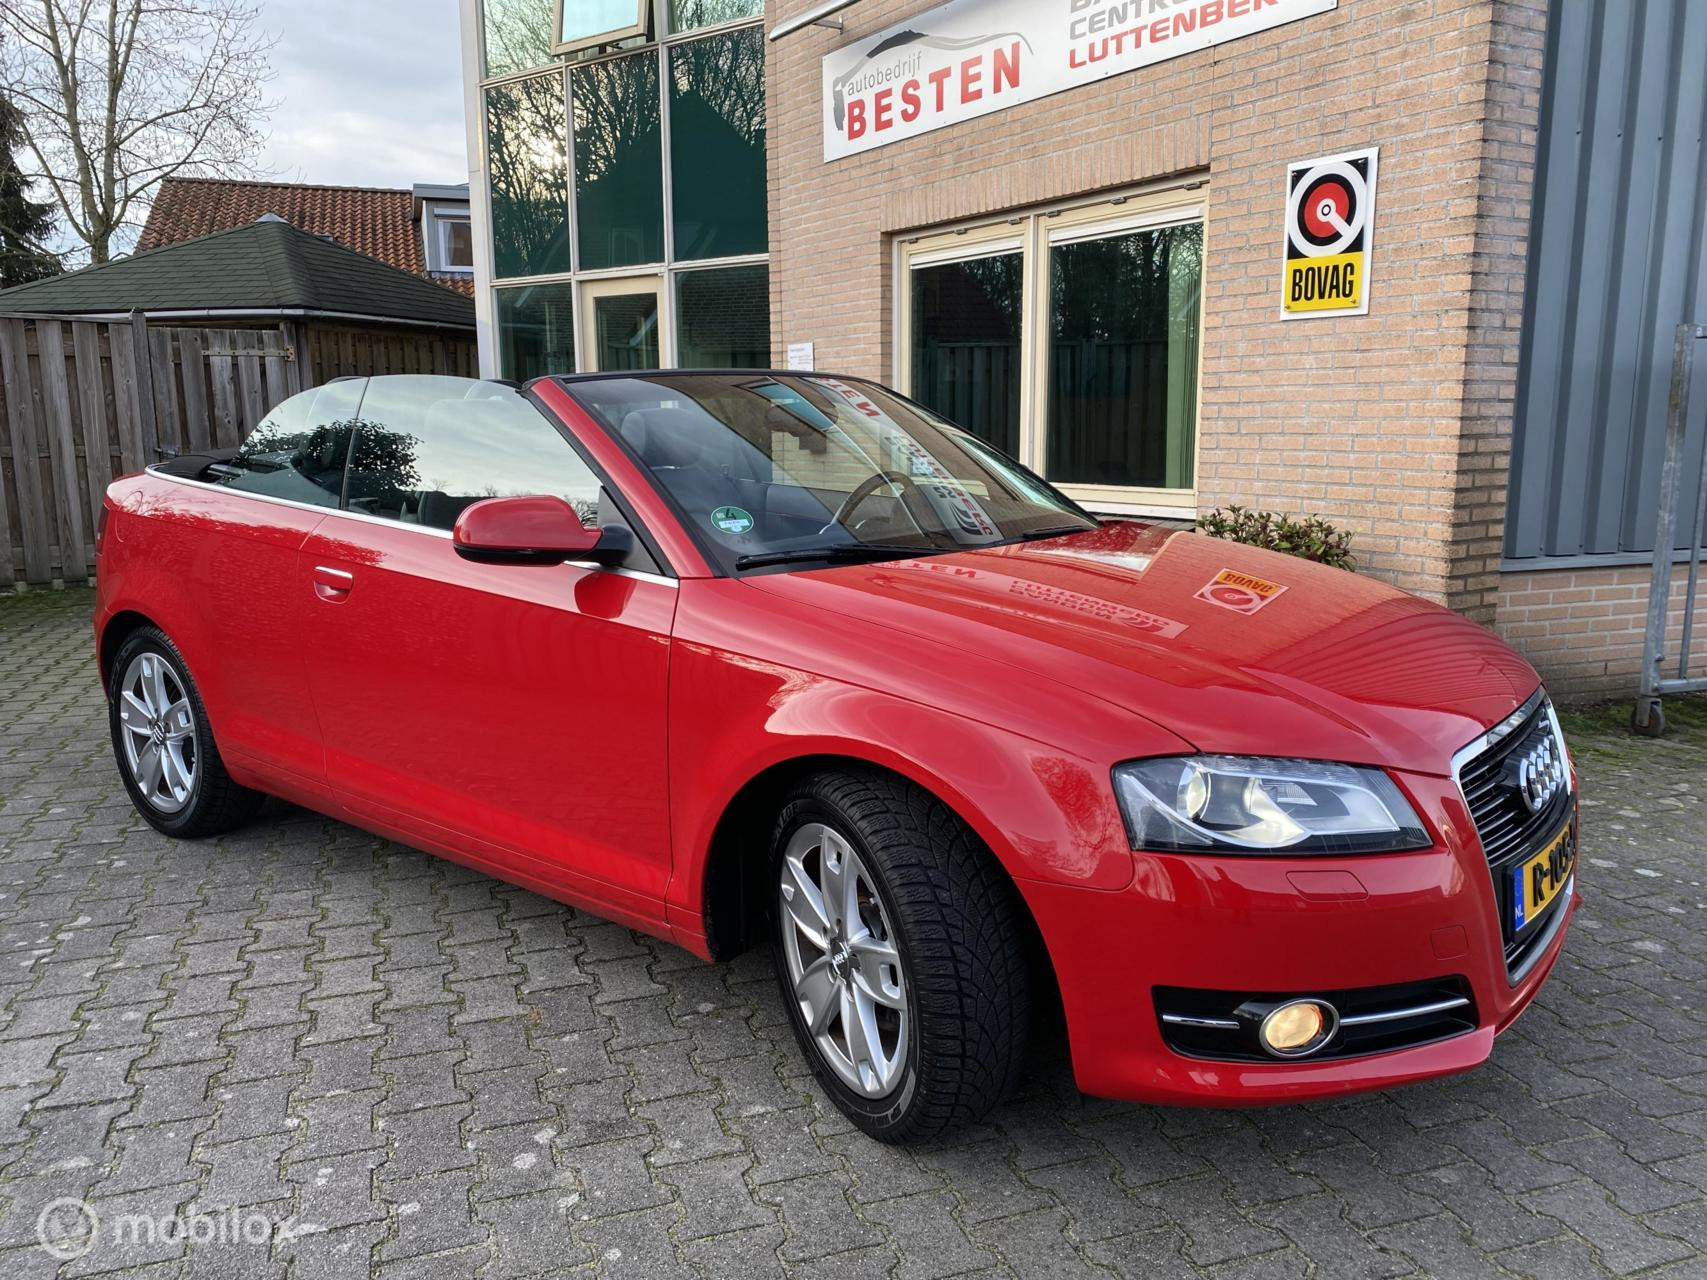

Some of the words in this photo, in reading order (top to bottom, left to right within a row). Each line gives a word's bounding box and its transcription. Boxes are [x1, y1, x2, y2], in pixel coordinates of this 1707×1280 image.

[1070, 0, 1187, 40] CENTR
[847, 51, 922, 96] autobedrijf
[847, 40, 1021, 141] BESTEN
[1291, 262, 1355, 302] BOVAG
[1514, 903, 1524, 920] NL
